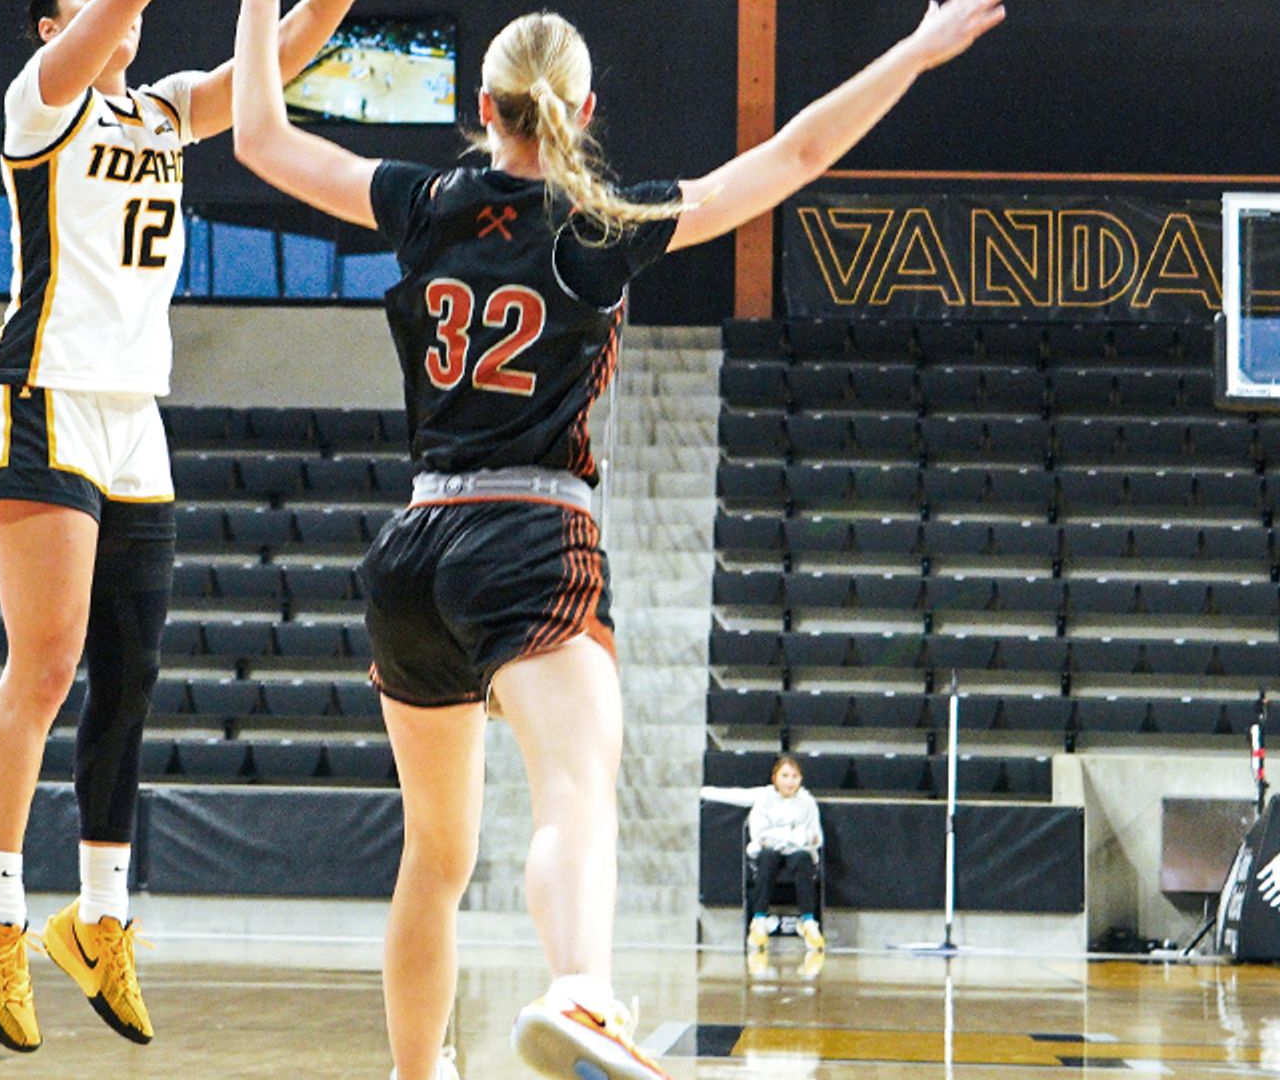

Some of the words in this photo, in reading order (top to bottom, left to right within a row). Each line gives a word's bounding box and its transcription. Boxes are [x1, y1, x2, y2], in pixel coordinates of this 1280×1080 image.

[85, 143, 183, 184] IDAH
[120, 198, 177, 269] 12
[425, 277, 547, 397] 32
